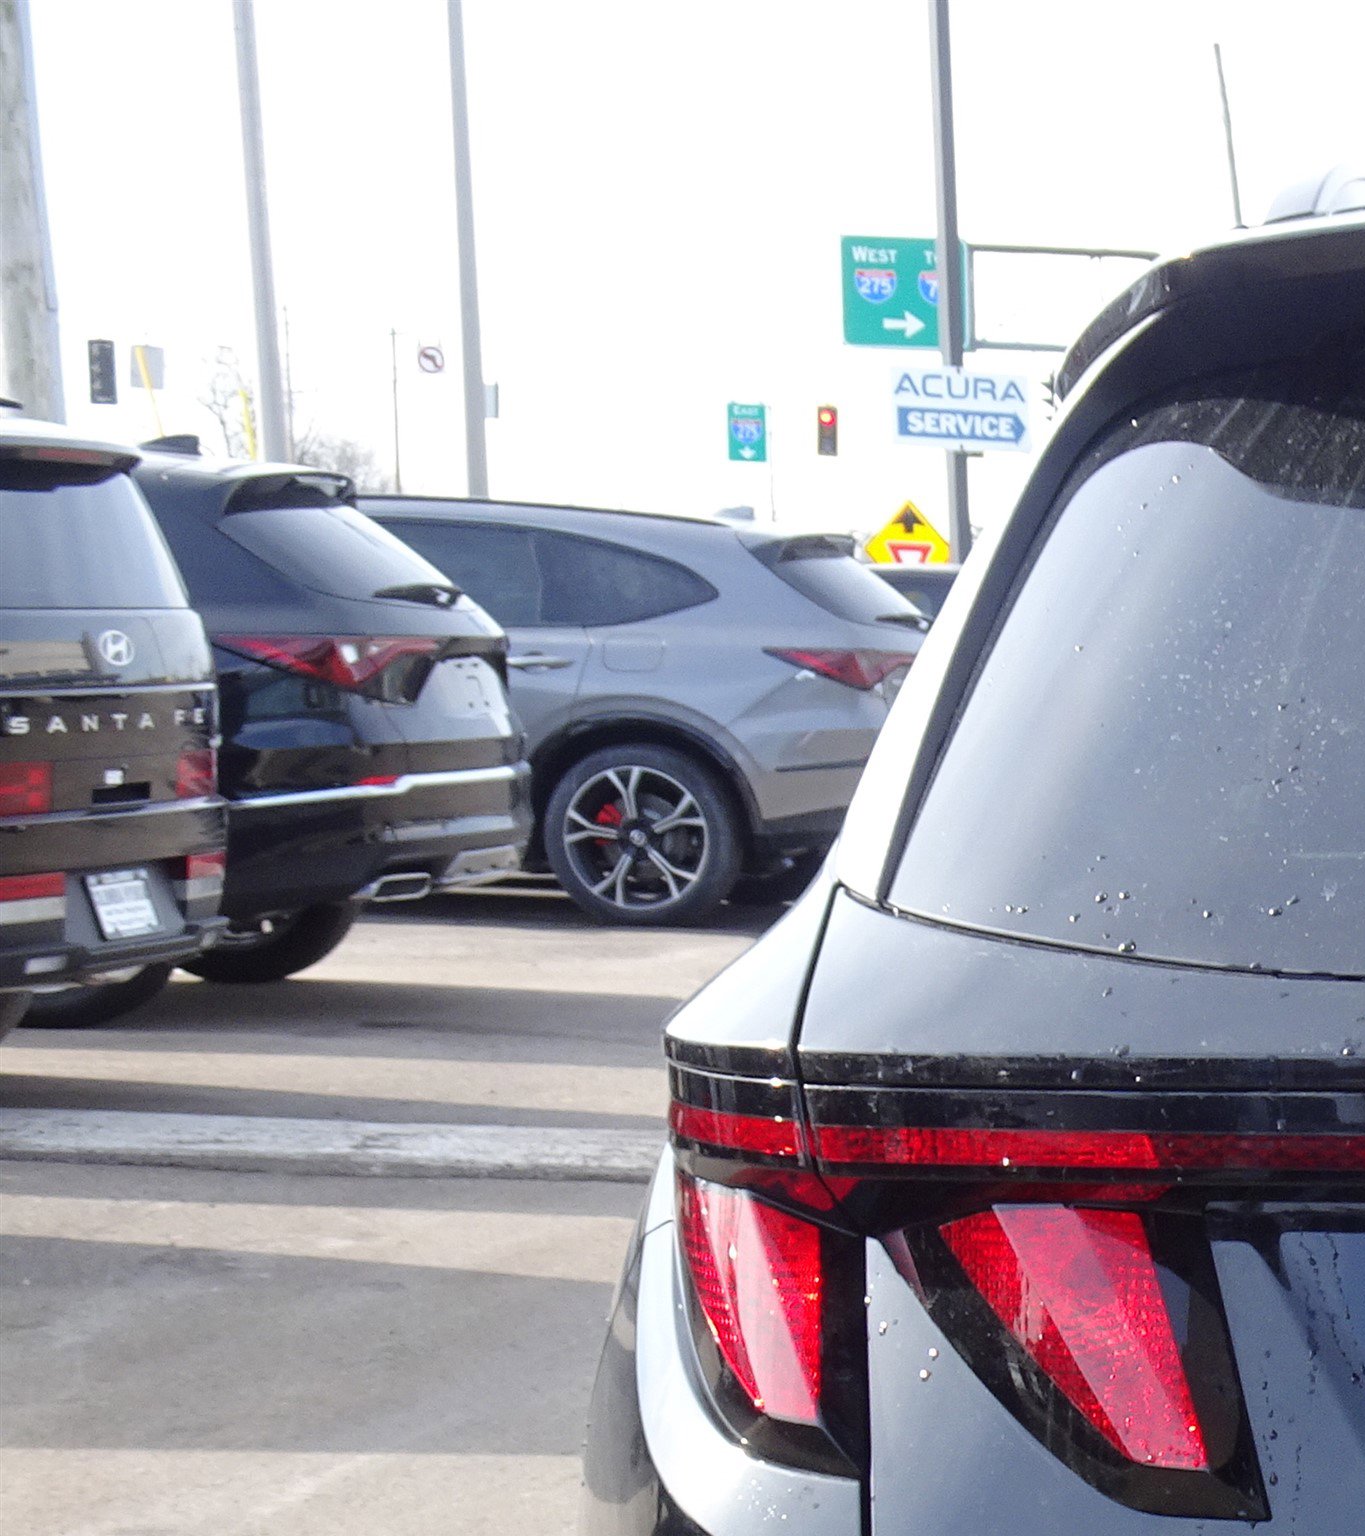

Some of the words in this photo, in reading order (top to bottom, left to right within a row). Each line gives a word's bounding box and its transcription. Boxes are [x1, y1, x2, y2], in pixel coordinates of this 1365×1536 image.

[851, 246, 898, 264] WEST
[860, 277, 892, 296] 275
[894, 373, 1026, 402] ACURA
[906, 411, 1018, 439] SERVICE
[7, 712, 155, 735] SANTA
[173, 707, 206, 726] FE
